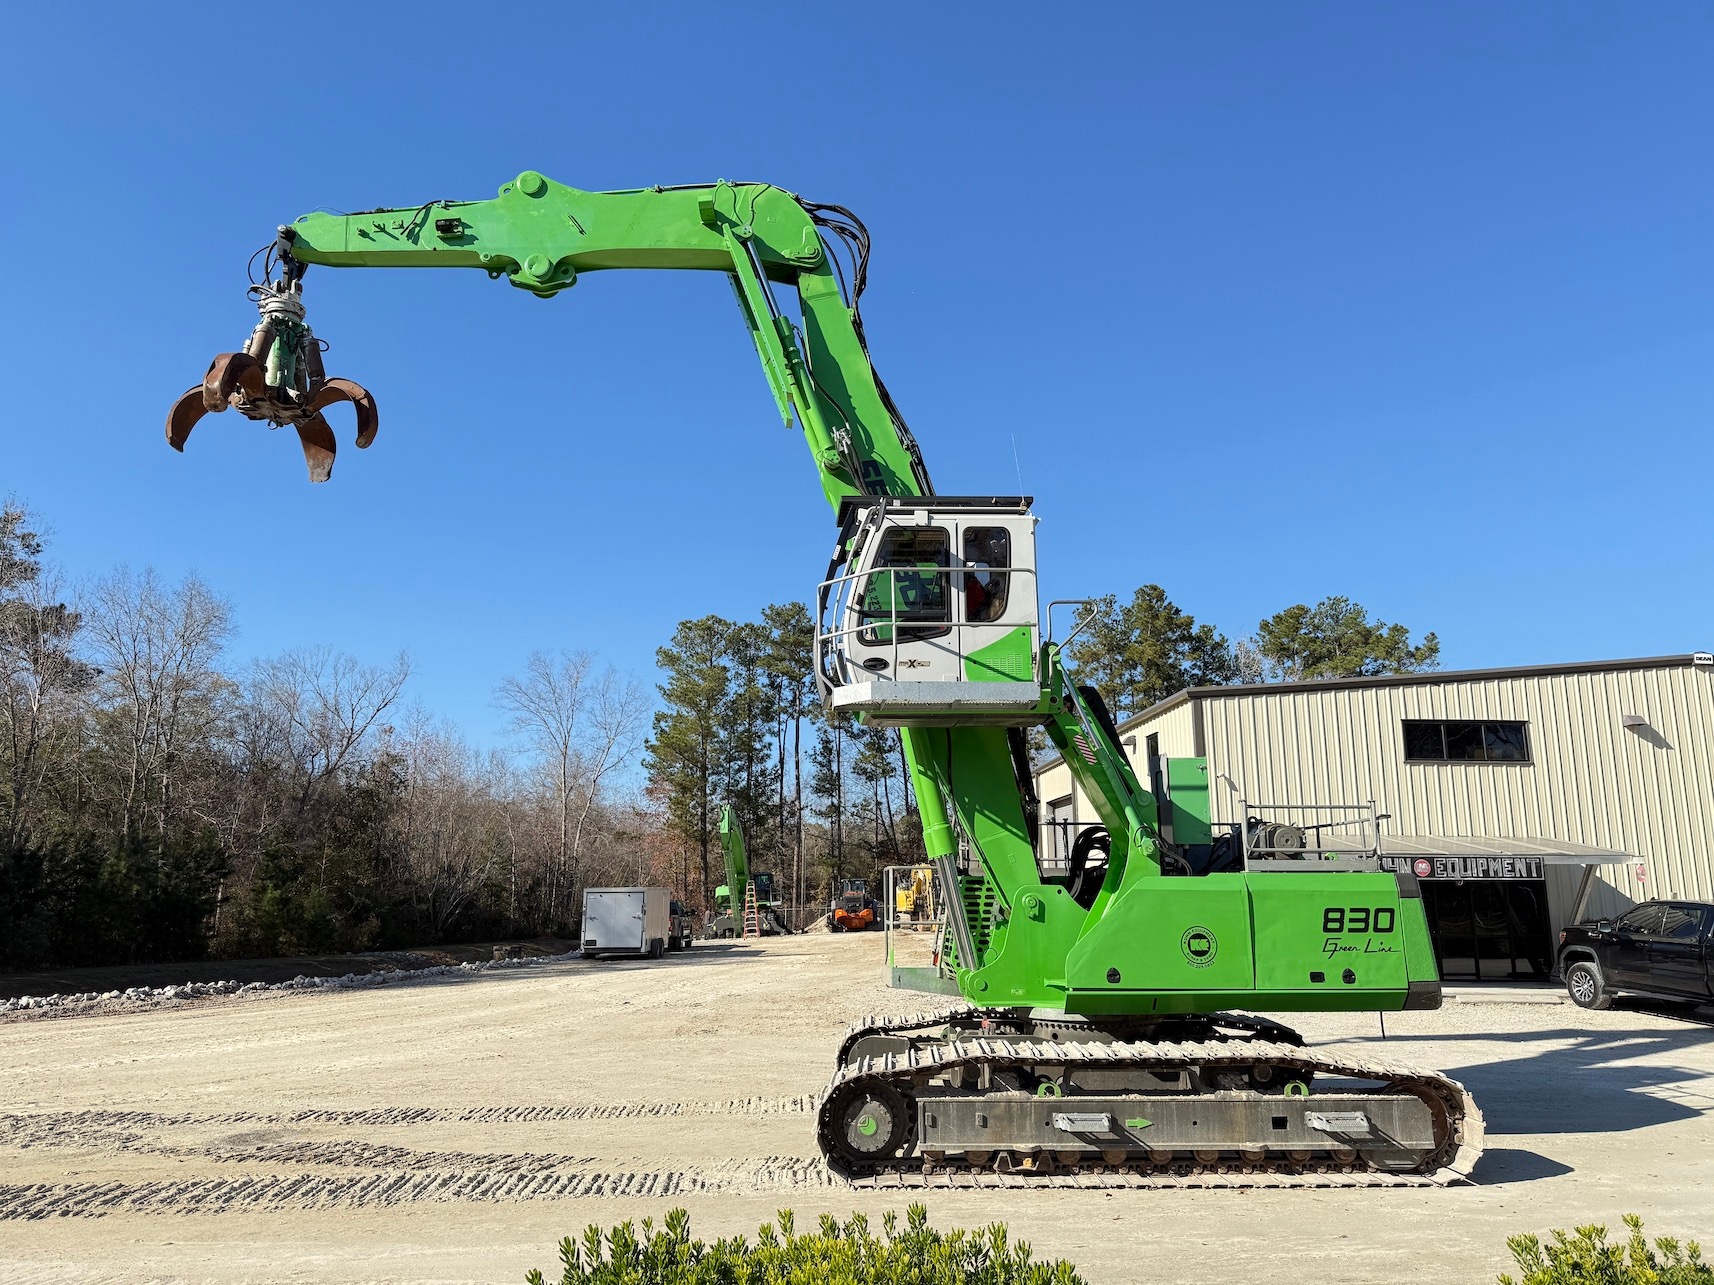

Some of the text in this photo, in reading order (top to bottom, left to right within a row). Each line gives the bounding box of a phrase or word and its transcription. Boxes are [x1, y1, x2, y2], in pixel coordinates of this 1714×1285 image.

[1434, 857, 1540, 878] EQUIPMENT
[1322, 907, 1395, 933] 830
[1322, 937, 1401, 960] Green Line
